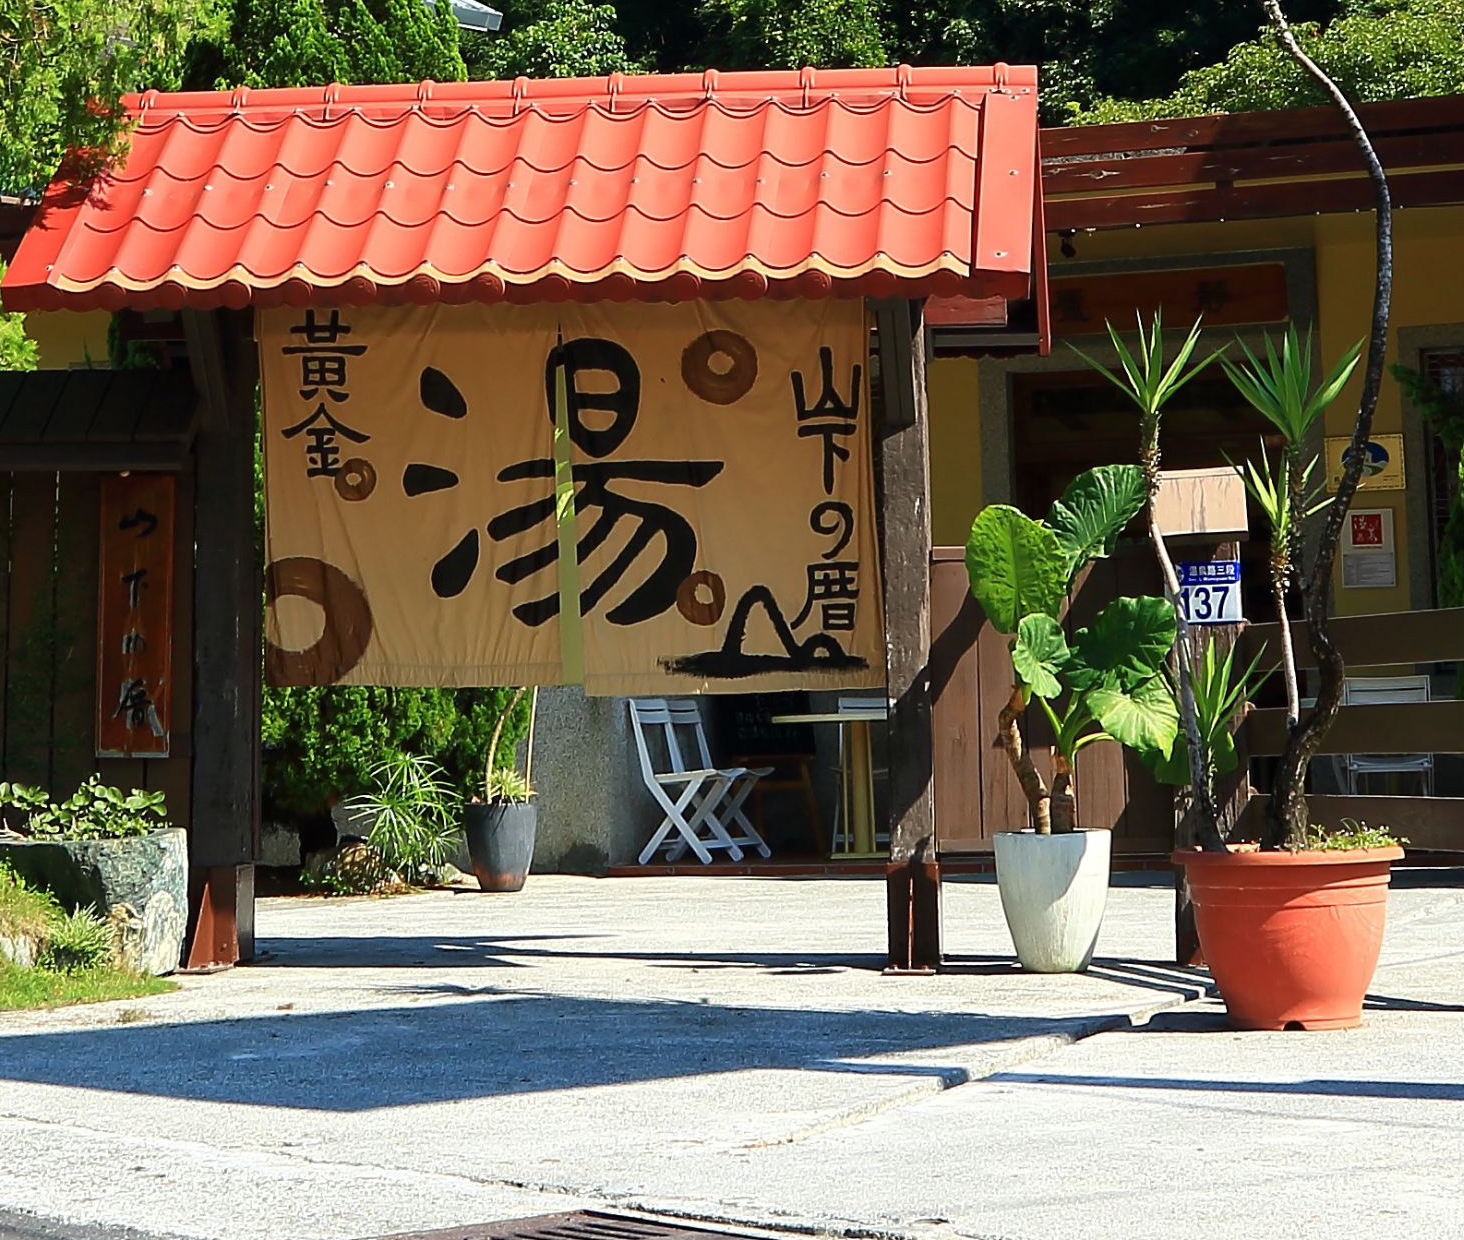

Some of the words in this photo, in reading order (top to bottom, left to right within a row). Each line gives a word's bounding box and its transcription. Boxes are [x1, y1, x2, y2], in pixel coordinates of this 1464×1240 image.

[281, 309, 371, 478] 黃金
[403, 337, 724, 626] 湯
[1180, 586, 1229, 619] 137
